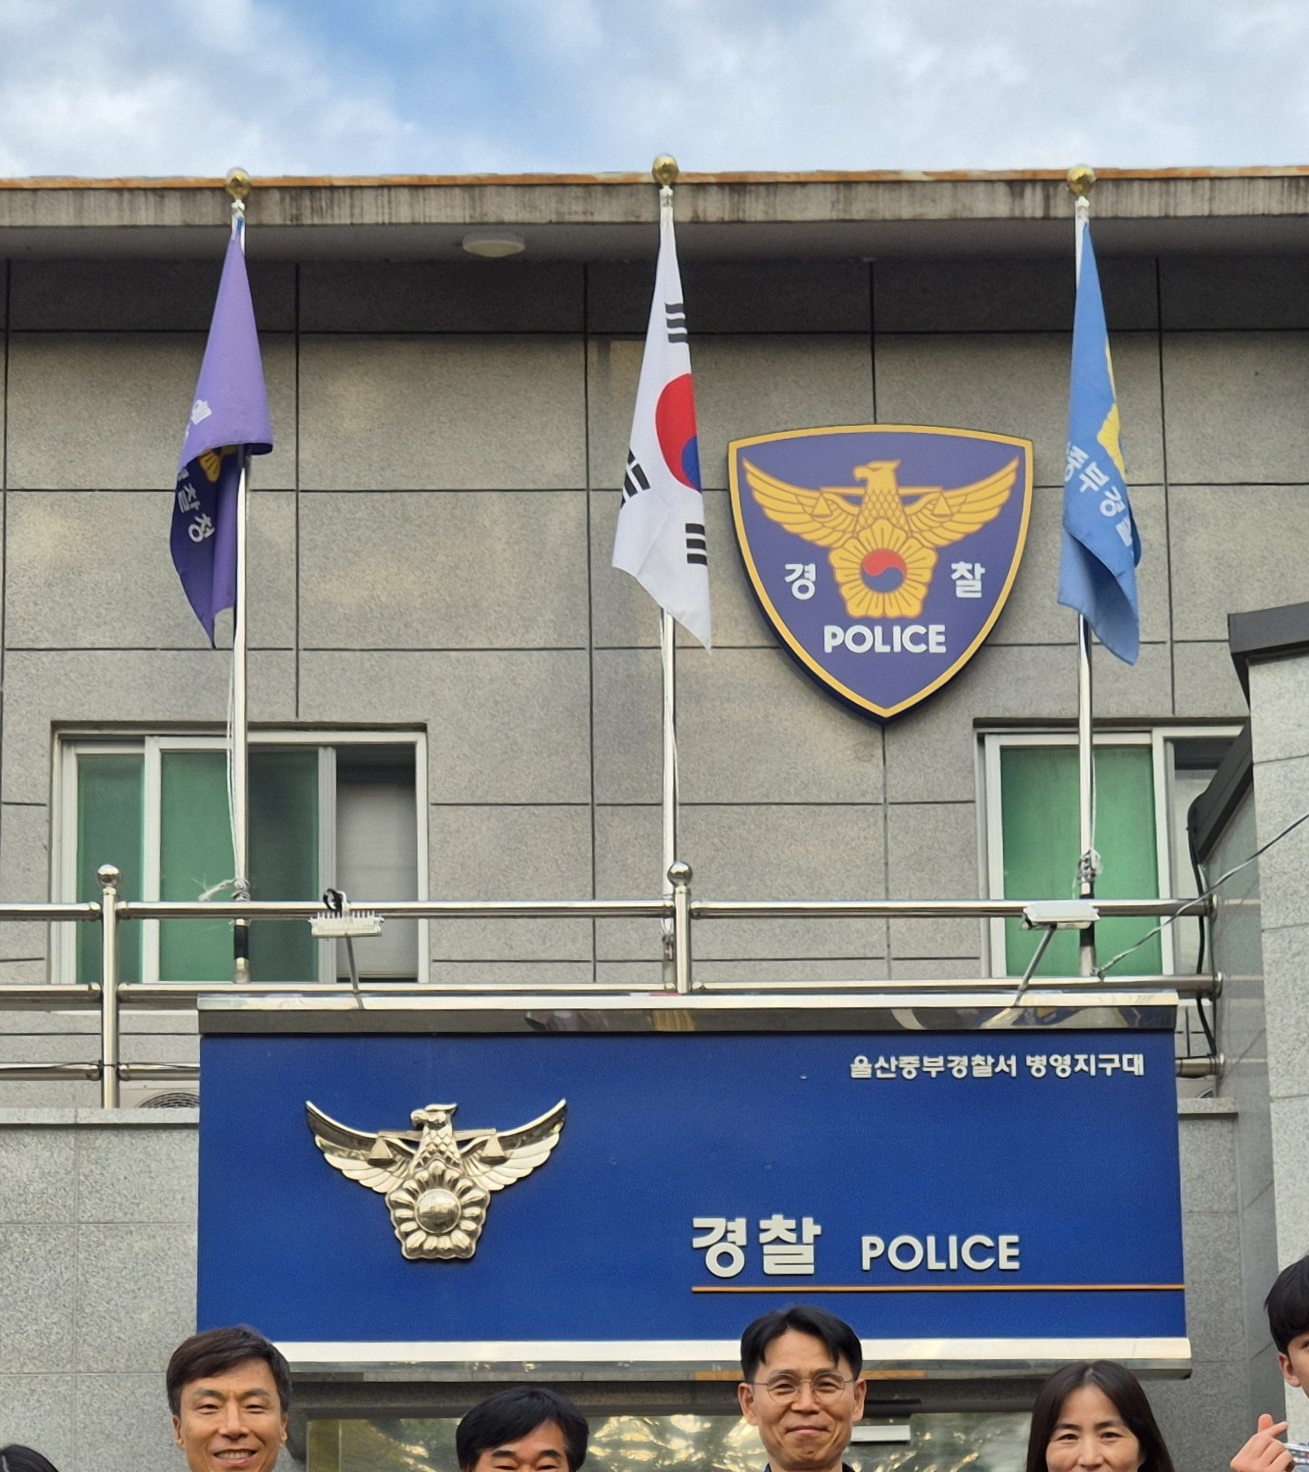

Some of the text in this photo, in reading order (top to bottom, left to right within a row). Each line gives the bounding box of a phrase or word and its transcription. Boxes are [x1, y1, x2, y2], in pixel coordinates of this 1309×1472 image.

[823, 624, 947, 654] POLICE
[850, 1053, 1145, 1080] 울산중부경찰서 병영지구대
[693, 1214, 1020, 1278] 경찰 POLICE
